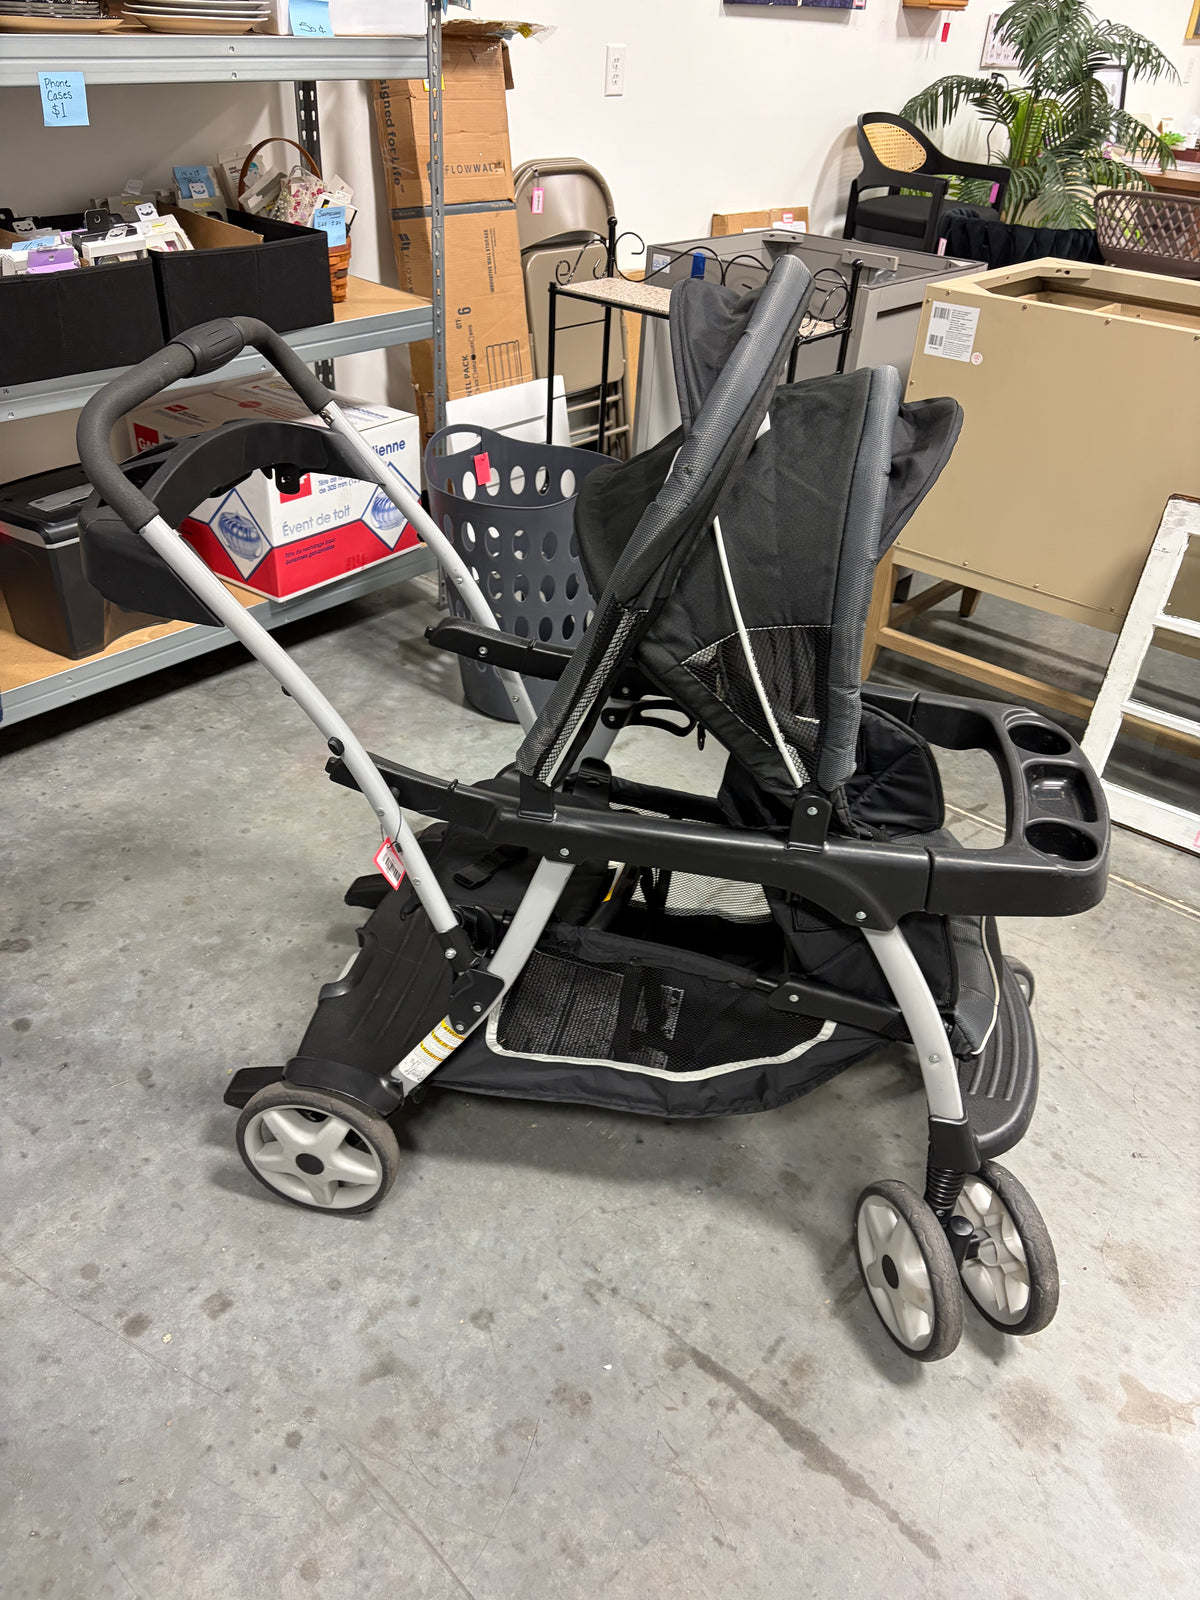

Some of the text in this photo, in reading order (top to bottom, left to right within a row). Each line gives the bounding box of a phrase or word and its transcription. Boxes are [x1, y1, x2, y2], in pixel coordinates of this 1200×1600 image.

[44, 77, 72, 90] Phone
[47, 89, 73, 102] Cases
[51, 102, 67, 119] $1
[387, 130, 398, 155] for
[445, 163, 500, 174] FLOWWAL
[457, 307, 471, 315] 6
[462, 355, 471, 379] PACK
[138, 437, 158, 450] GA
[282, 504, 350, 537] Évent de toit
